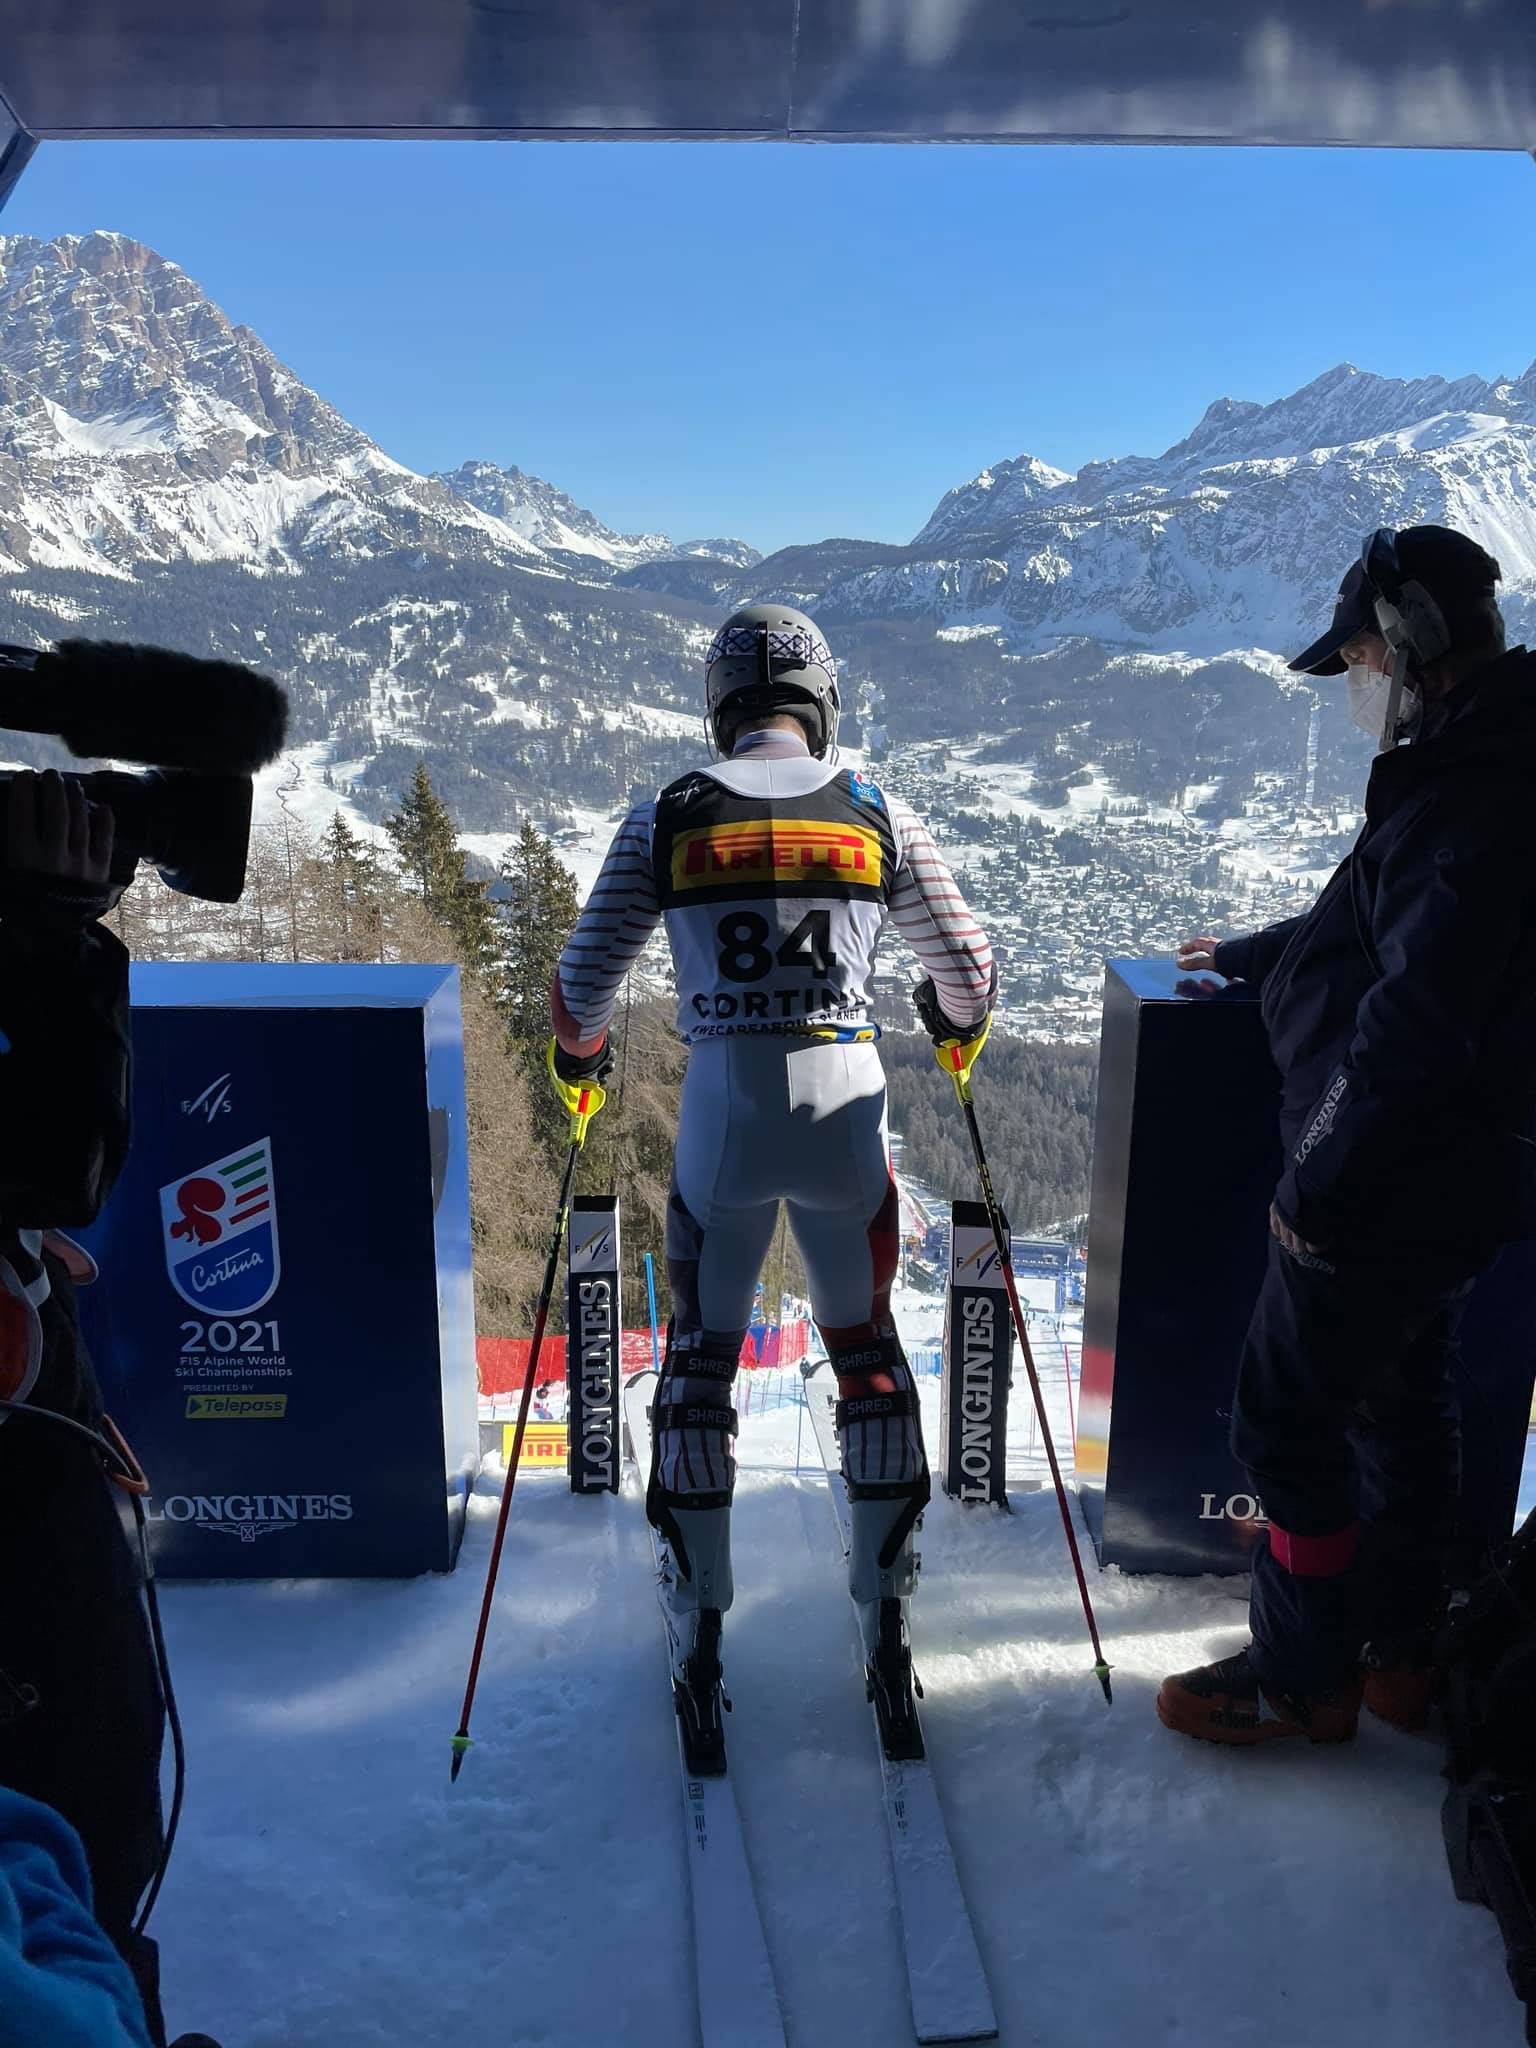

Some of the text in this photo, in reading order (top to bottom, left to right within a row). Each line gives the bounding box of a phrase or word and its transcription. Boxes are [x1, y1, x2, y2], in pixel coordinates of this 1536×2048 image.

[685, 831, 866, 876] PIRELLI
[717, 910, 837, 984] 84
[691, 987, 867, 1020] CORTINA
[1295, 1075, 1348, 1166] LONGINES
[191, 1248, 265, 1293] Cortina
[179, 1320, 280, 1352] 2021
[175, 1367, 293, 1378] Ski Championships
[180, 1356, 286, 1368] FIS Alpine World
[688, 1357, 732, 1376] SHRED
[838, 1350, 881, 1370] SHRED
[183, 1384, 239, 1392] PRESENTED
[579, 1280, 612, 1488] LONGINES
[204, 1398, 282, 1414] Telepass
[847, 1398, 892, 1416] SHRED
[961, 1297, 995, 1503] LONGINES
[687, 1408, 730, 1425] SHRED
[141, 1495, 353, 1522] LONGINES
